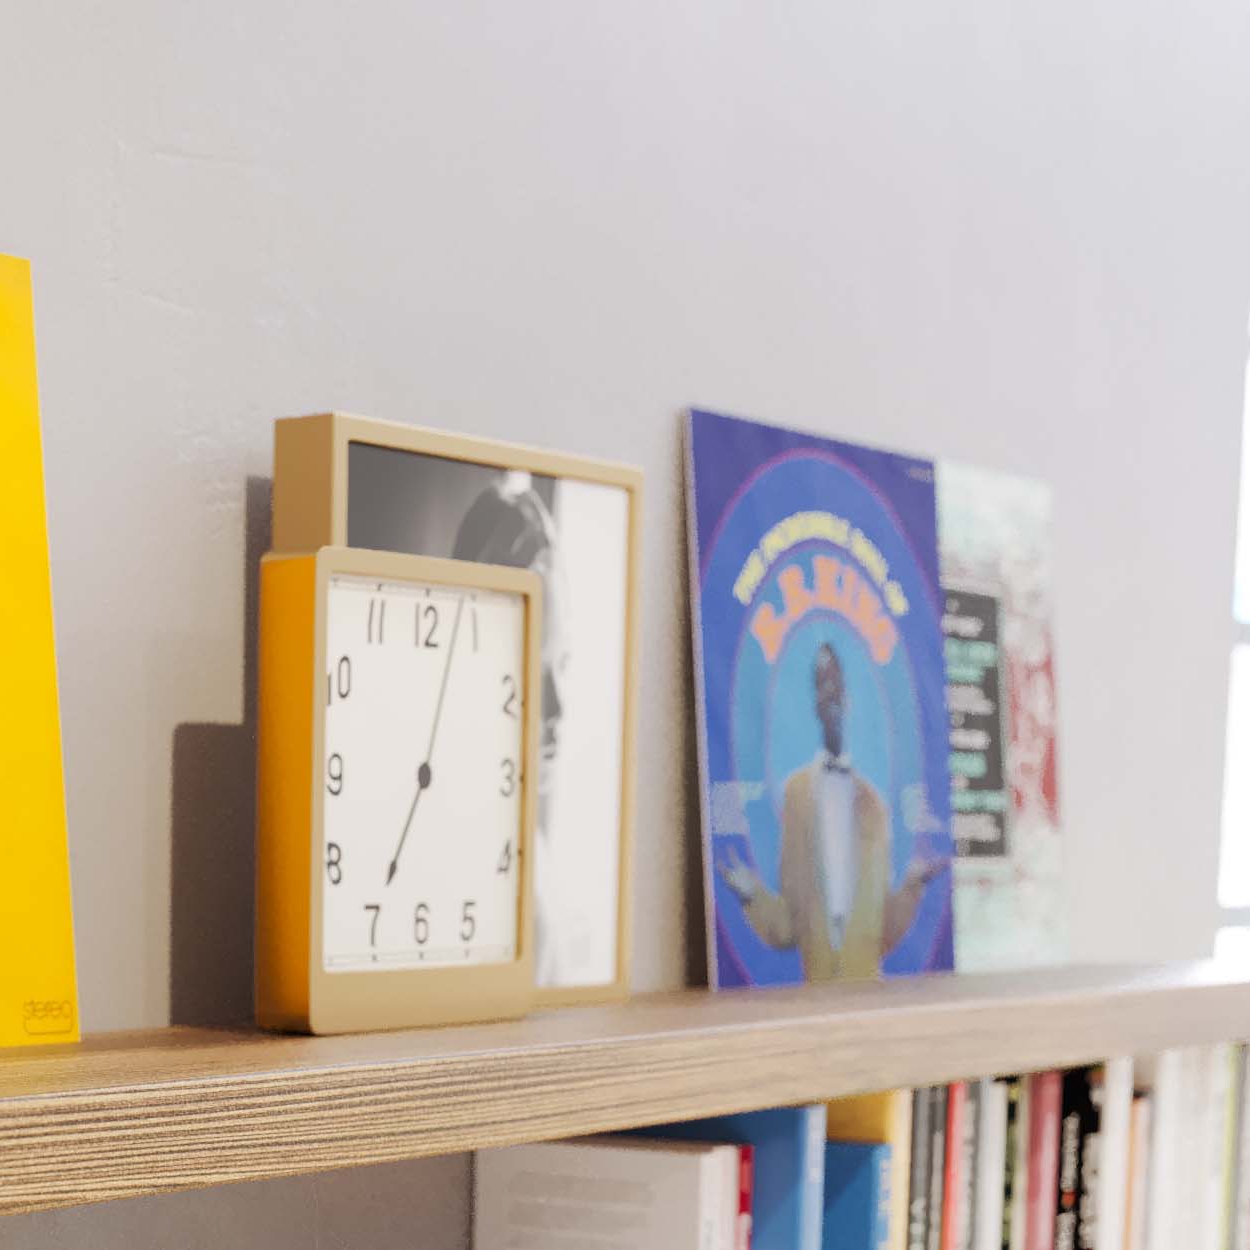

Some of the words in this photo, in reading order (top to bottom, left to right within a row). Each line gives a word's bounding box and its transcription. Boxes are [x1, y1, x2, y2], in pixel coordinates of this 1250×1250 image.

[367, 597, 385, 645] 11
[414, 604, 439, 649] 12
[327, 655, 351, 706] 10
[501, 674, 518, 719] 2
[327, 753, 343, 796] 9
[499, 757, 516, 798] 3
[326, 842, 342, 886] 8
[364, 904, 380, 947] 7
[414, 902, 430, 945] 6
[460, 901, 476, 942] 5
